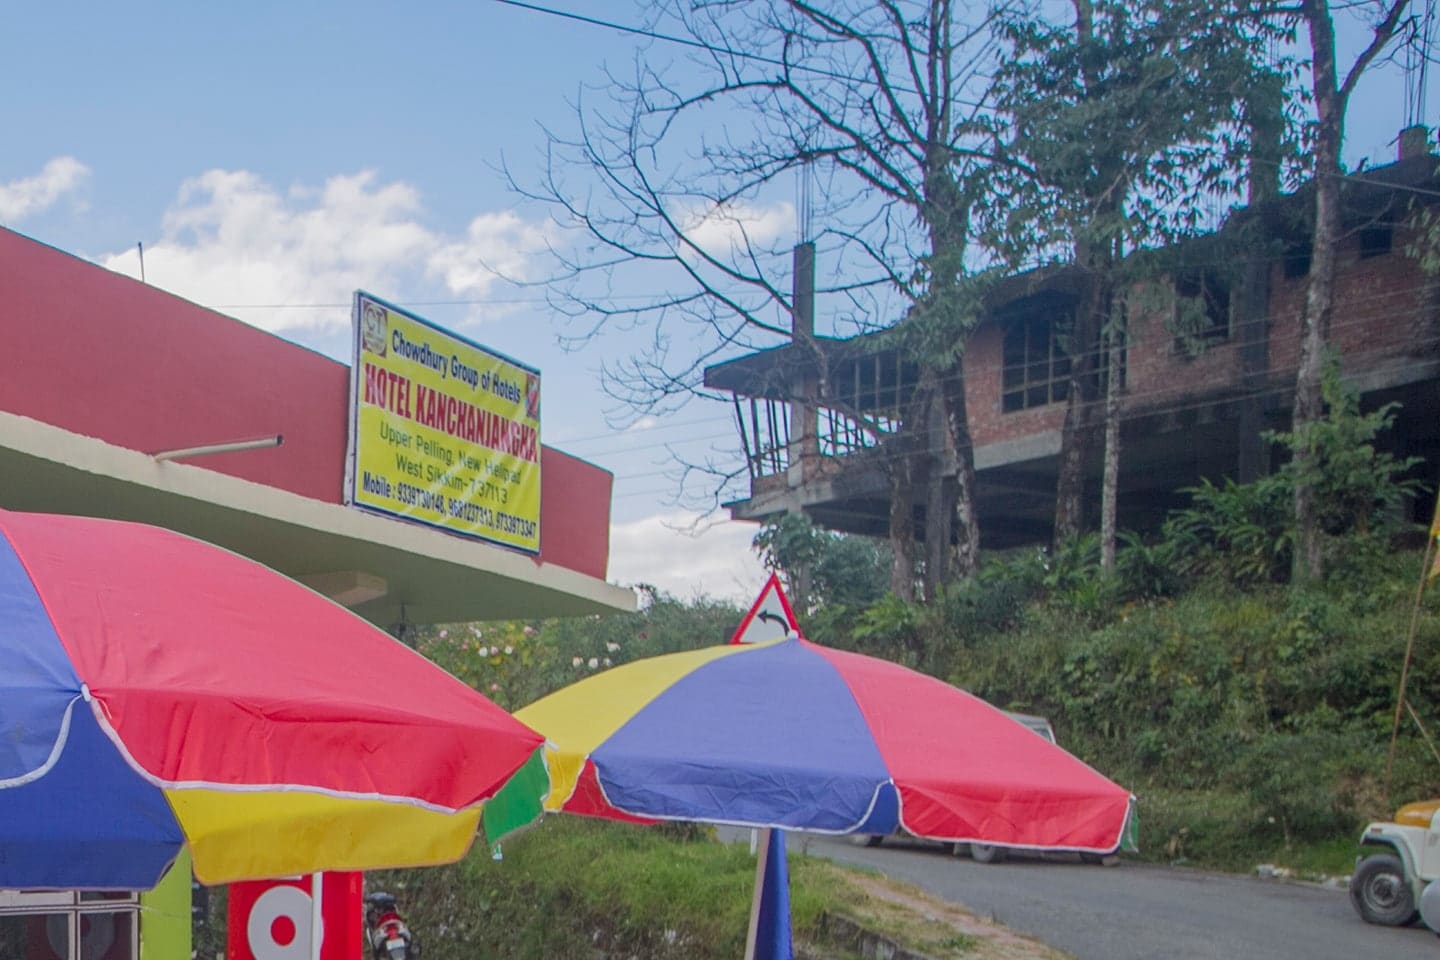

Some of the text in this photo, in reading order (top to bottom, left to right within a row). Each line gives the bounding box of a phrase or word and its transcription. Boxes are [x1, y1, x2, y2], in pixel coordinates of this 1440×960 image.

[392, 329, 449, 380] Chowdhury
[451, 355, 479, 391] Group
[481, 371, 491, 391] of
[492, 373, 521, 405] Hotels
[365, 362, 538, 463] HOTEL KANCHANJANGHA
[380, 421, 412, 449] Upper
[459, 450, 481, 473] New
[396, 453, 424, 479] West
